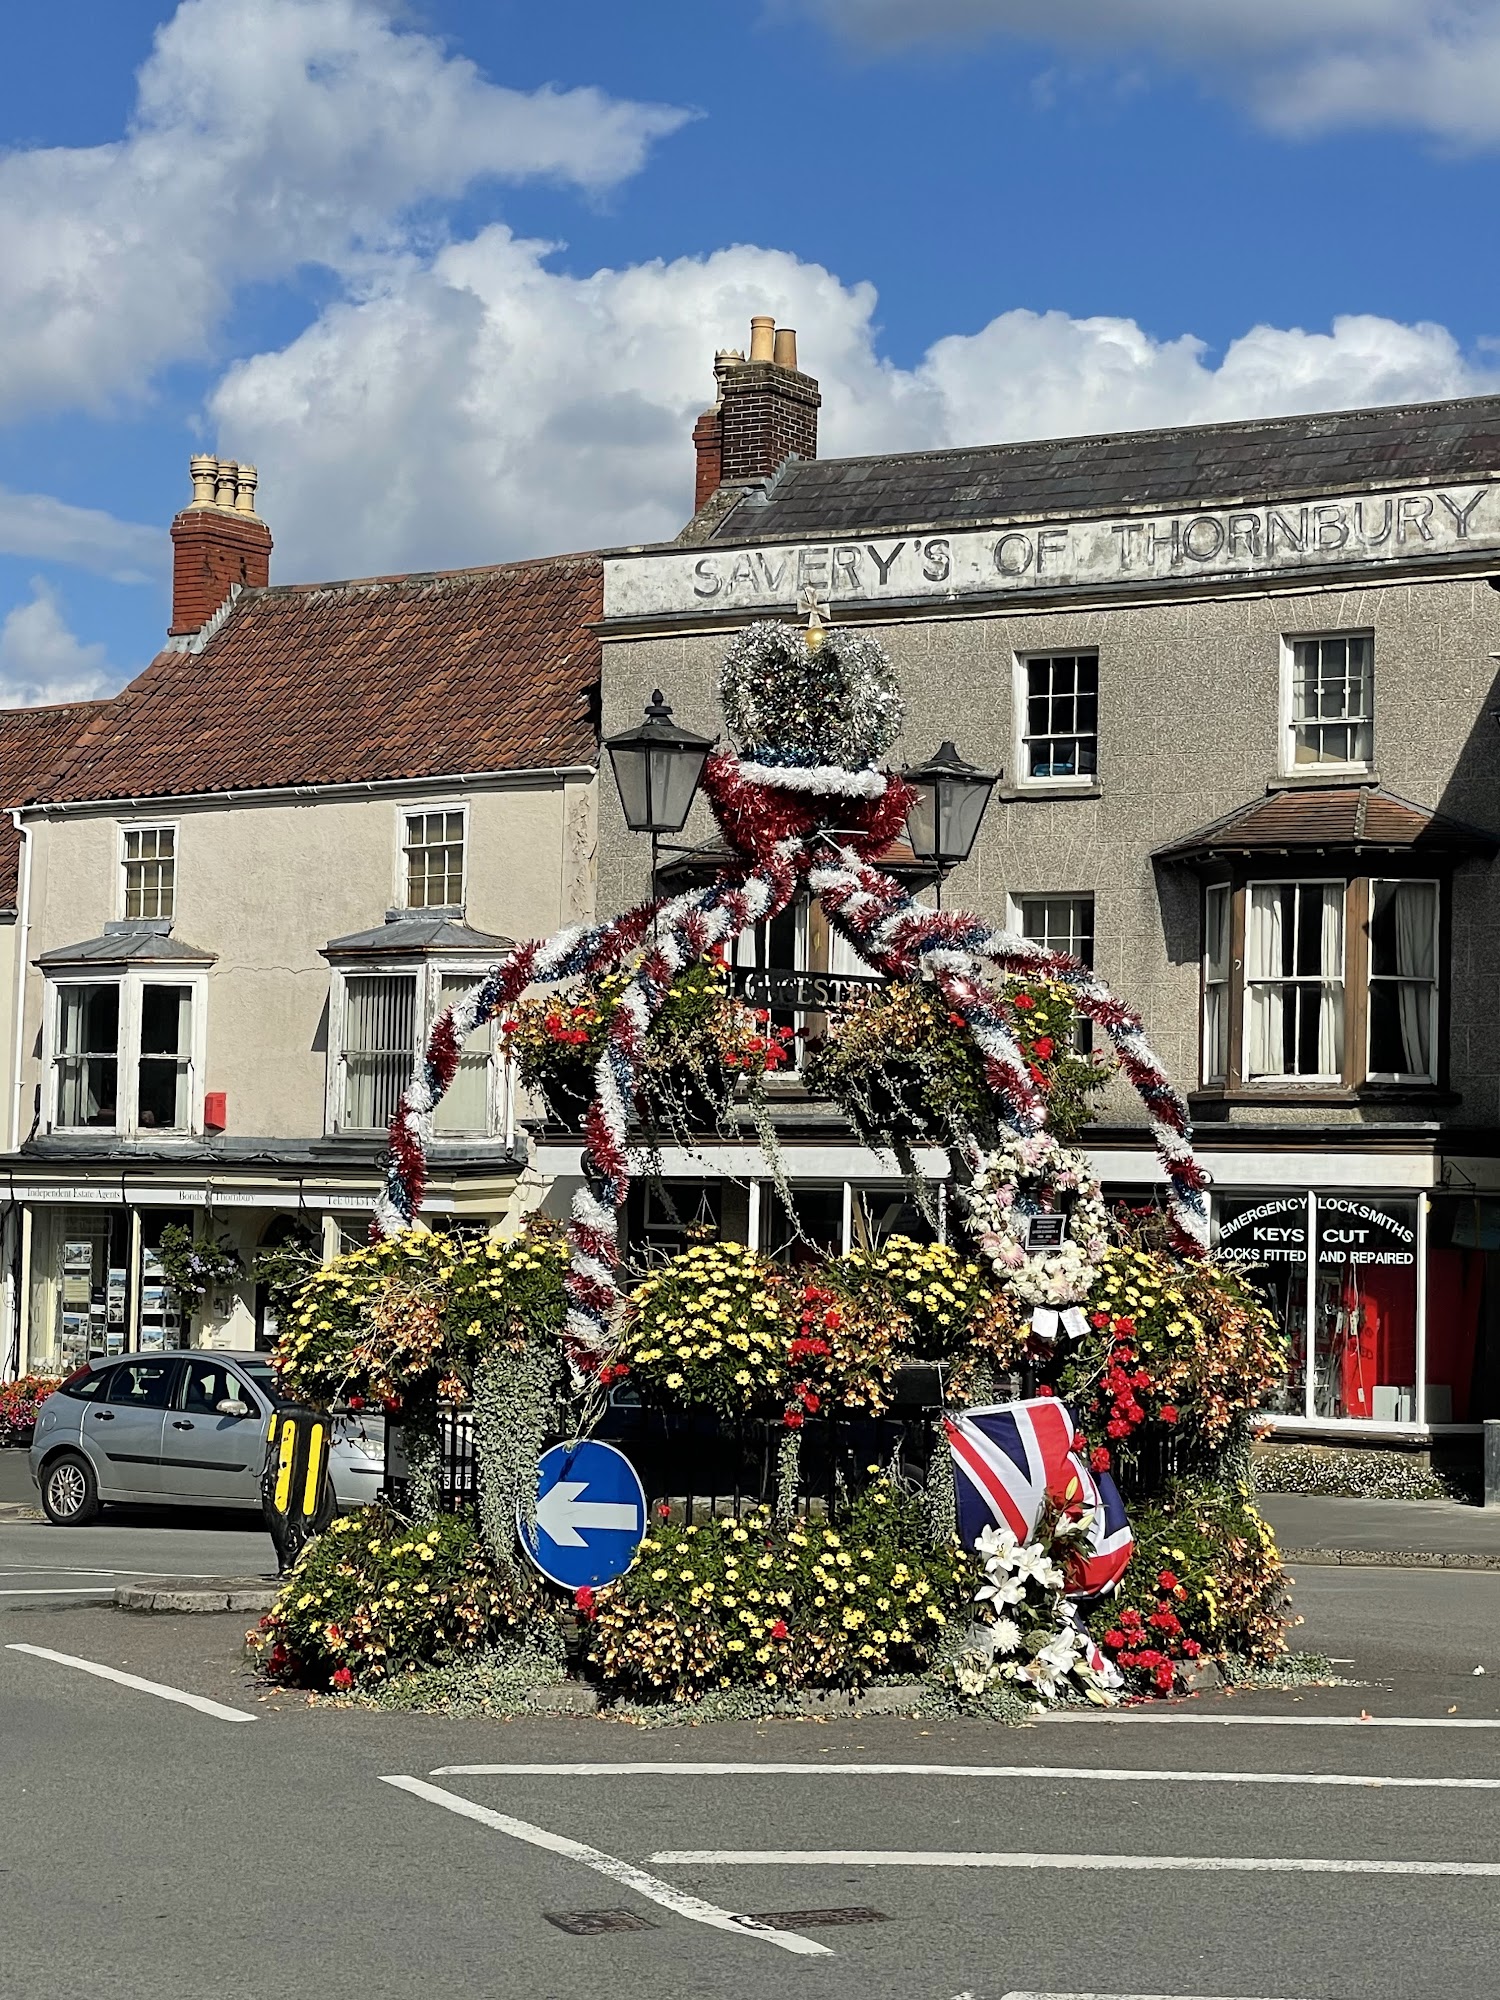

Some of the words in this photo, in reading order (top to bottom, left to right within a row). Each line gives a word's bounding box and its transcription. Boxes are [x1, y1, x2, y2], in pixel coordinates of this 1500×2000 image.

[693, 539, 951, 598] SAVERY'S
[993, 530, 1069, 577] OF
[1111, 489, 1489, 569] THORNBURY
[27, 1187, 71, 1199] Independent
[74, 1188, 93, 1198] Estate
[96, 1189, 120, 1199] Agents
[179, 1190, 202, 1201] Bonds
[214, 1191, 255, 1204] Thornbury
[1218, 1197, 1308, 1240] EMERGENCY
[1317, 1197, 1414, 1243] LOCKSMITHS
[1253, 1226, 1305, 1242] KEYS
[1322, 1229, 1370, 1244] CUT
[1217, 1246, 1260, 1261] LOCKS
[1263, 1248, 1307, 1263] FITTED
[1319, 1250, 1347, 1264] AND
[1350, 1251, 1414, 1265] REPAIRED
